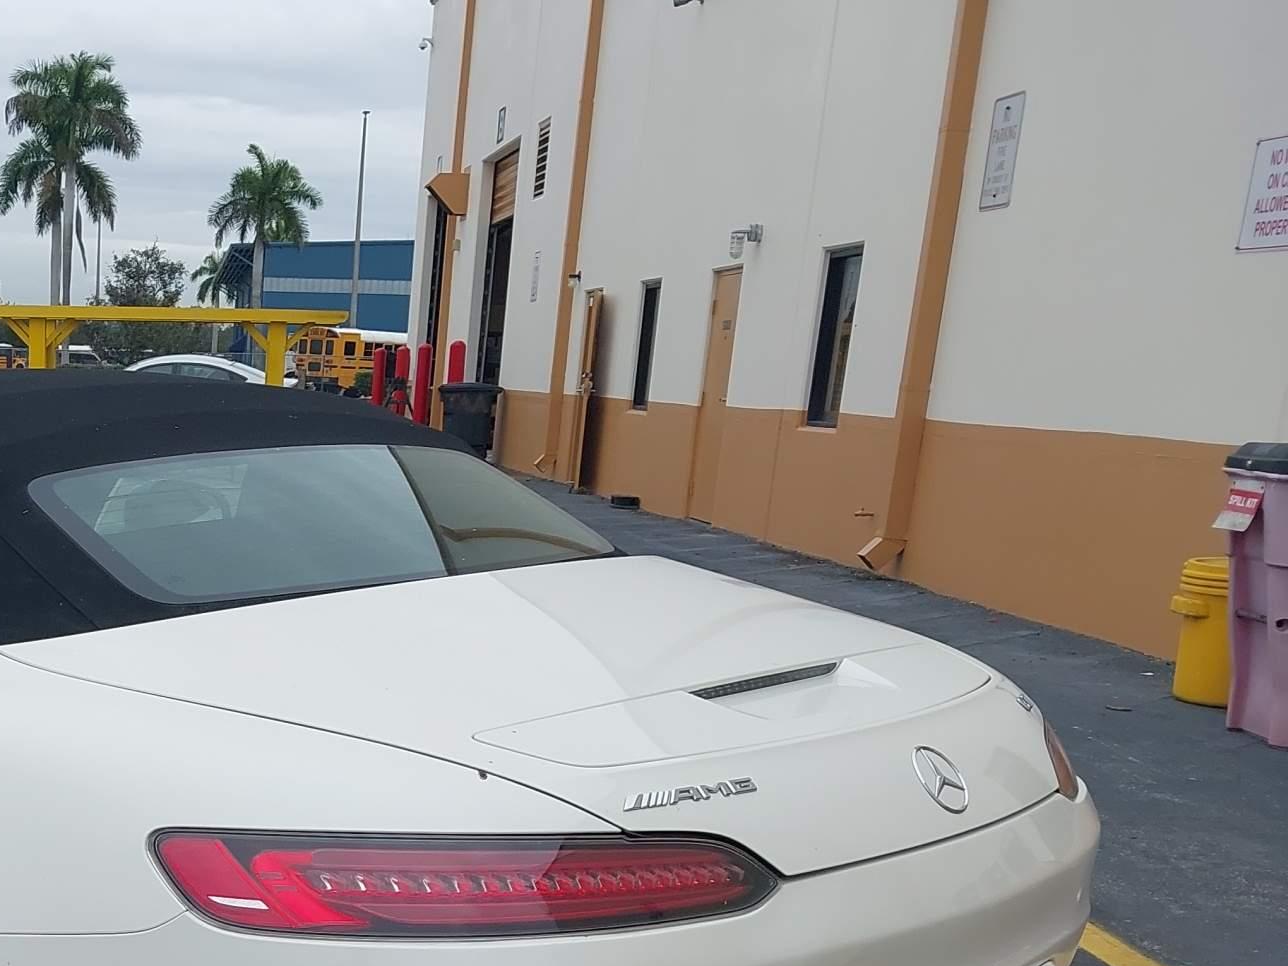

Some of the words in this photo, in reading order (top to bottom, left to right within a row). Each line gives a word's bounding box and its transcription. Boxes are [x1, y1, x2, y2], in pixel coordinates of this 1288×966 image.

[1271, 148, 1284, 166] NO
[1267, 172, 1282, 189] ON
[1228, 494, 1246, 506] SPILL
[1245, 497, 1259, 509] KIT
[669, 776, 758, 806] AMG
